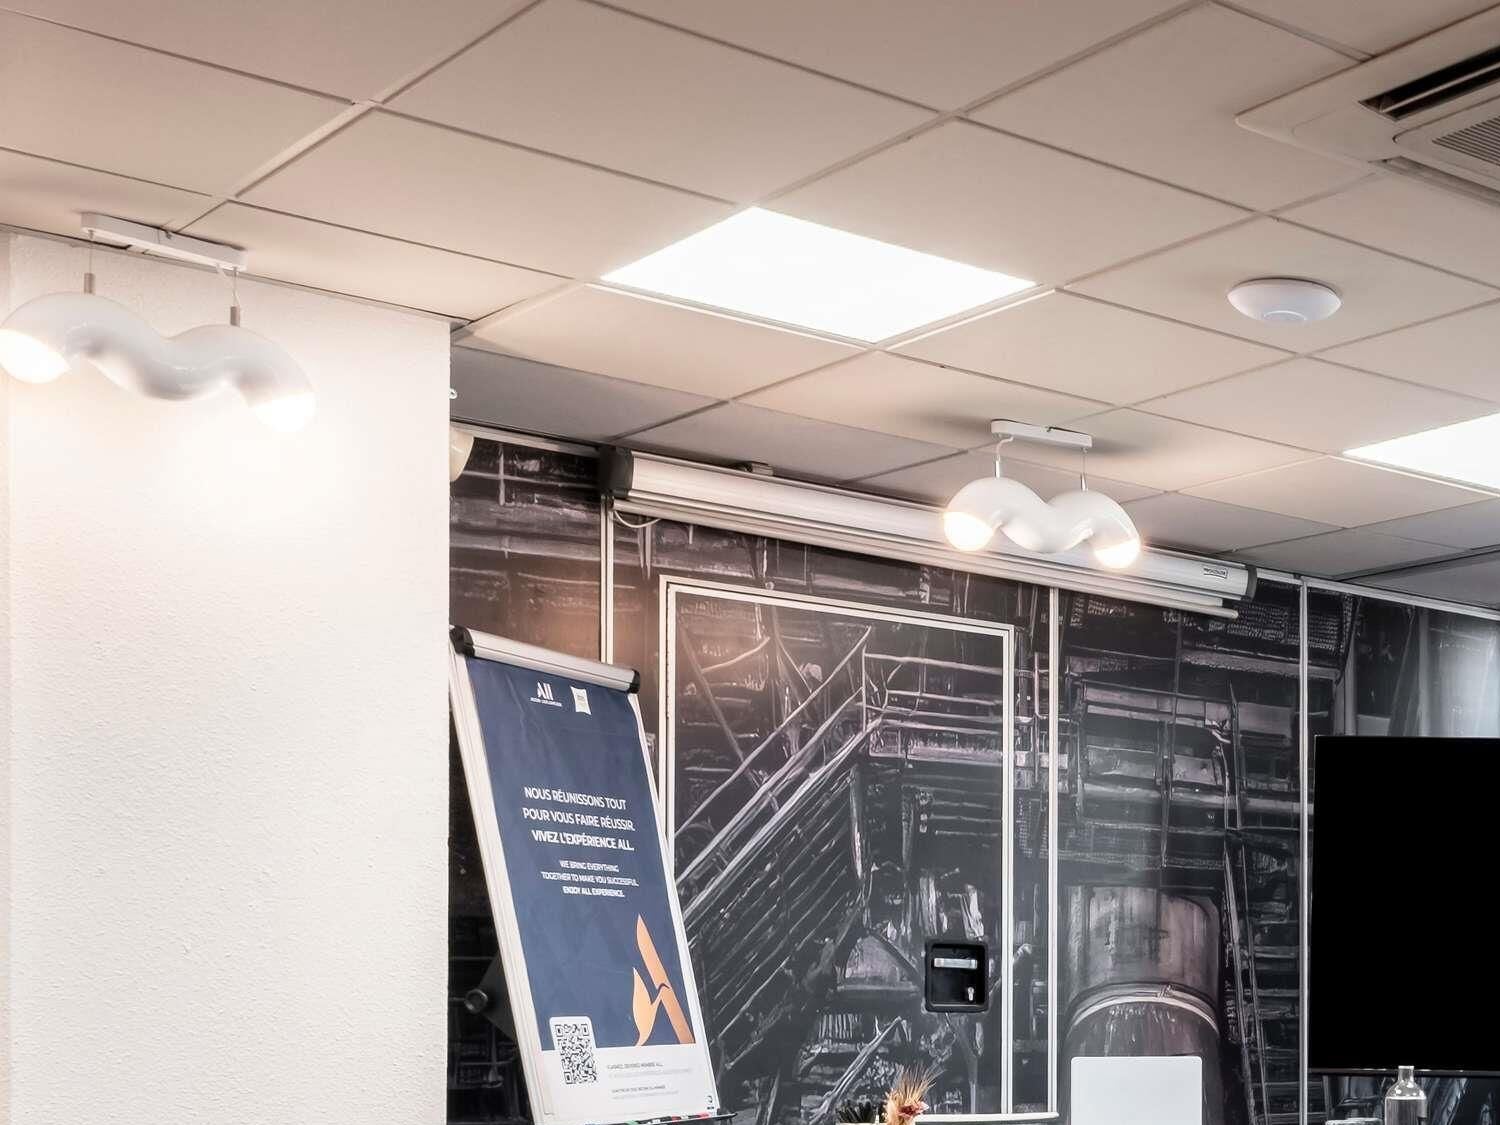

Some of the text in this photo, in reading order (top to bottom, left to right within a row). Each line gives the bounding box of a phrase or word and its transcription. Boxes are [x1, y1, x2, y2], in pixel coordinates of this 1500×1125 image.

[524, 787, 626, 810] NOUS RÉUNISSONS TOUT
[522, 807, 635, 831] POUR VOUS FAIRE RÉUSSIR.
[531, 830, 635, 851] VIVEZ L'EXPÉRIENCE ALL.
[559, 860, 619, 872] WE BRING EVERYTHING
[541, 871, 571, 881] TOGETHER
[571, 873, 579, 882] TO
[579, 874, 595, 883] MAKE
[595, 875, 606, 884] YOU
[562, 886, 580, 894] ENJOY
[581, 887, 592, 895] ALL
